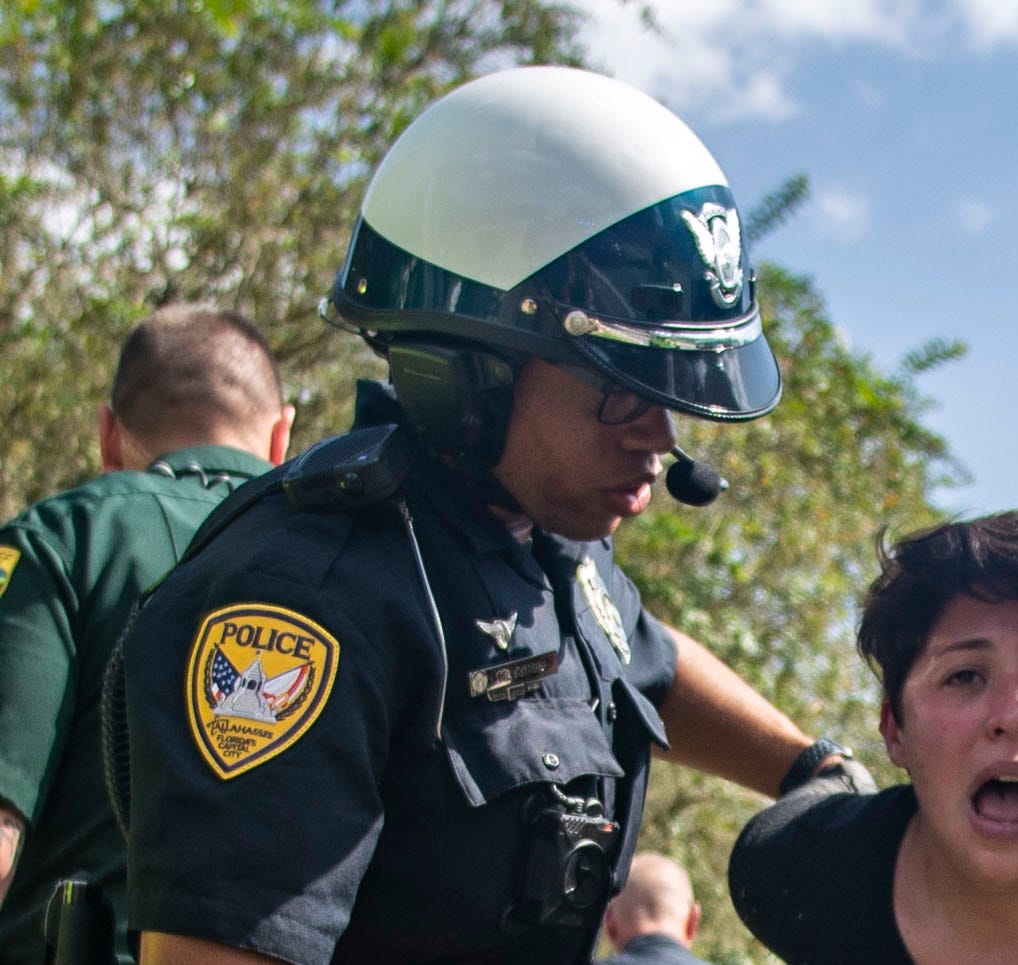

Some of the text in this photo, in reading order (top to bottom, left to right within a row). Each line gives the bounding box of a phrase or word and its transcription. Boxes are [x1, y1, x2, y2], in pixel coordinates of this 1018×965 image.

[220, 622, 315, 660] POLICE
[206, 716, 274, 739] TALLAHASSEE
[223, 750, 241, 758] CITY
